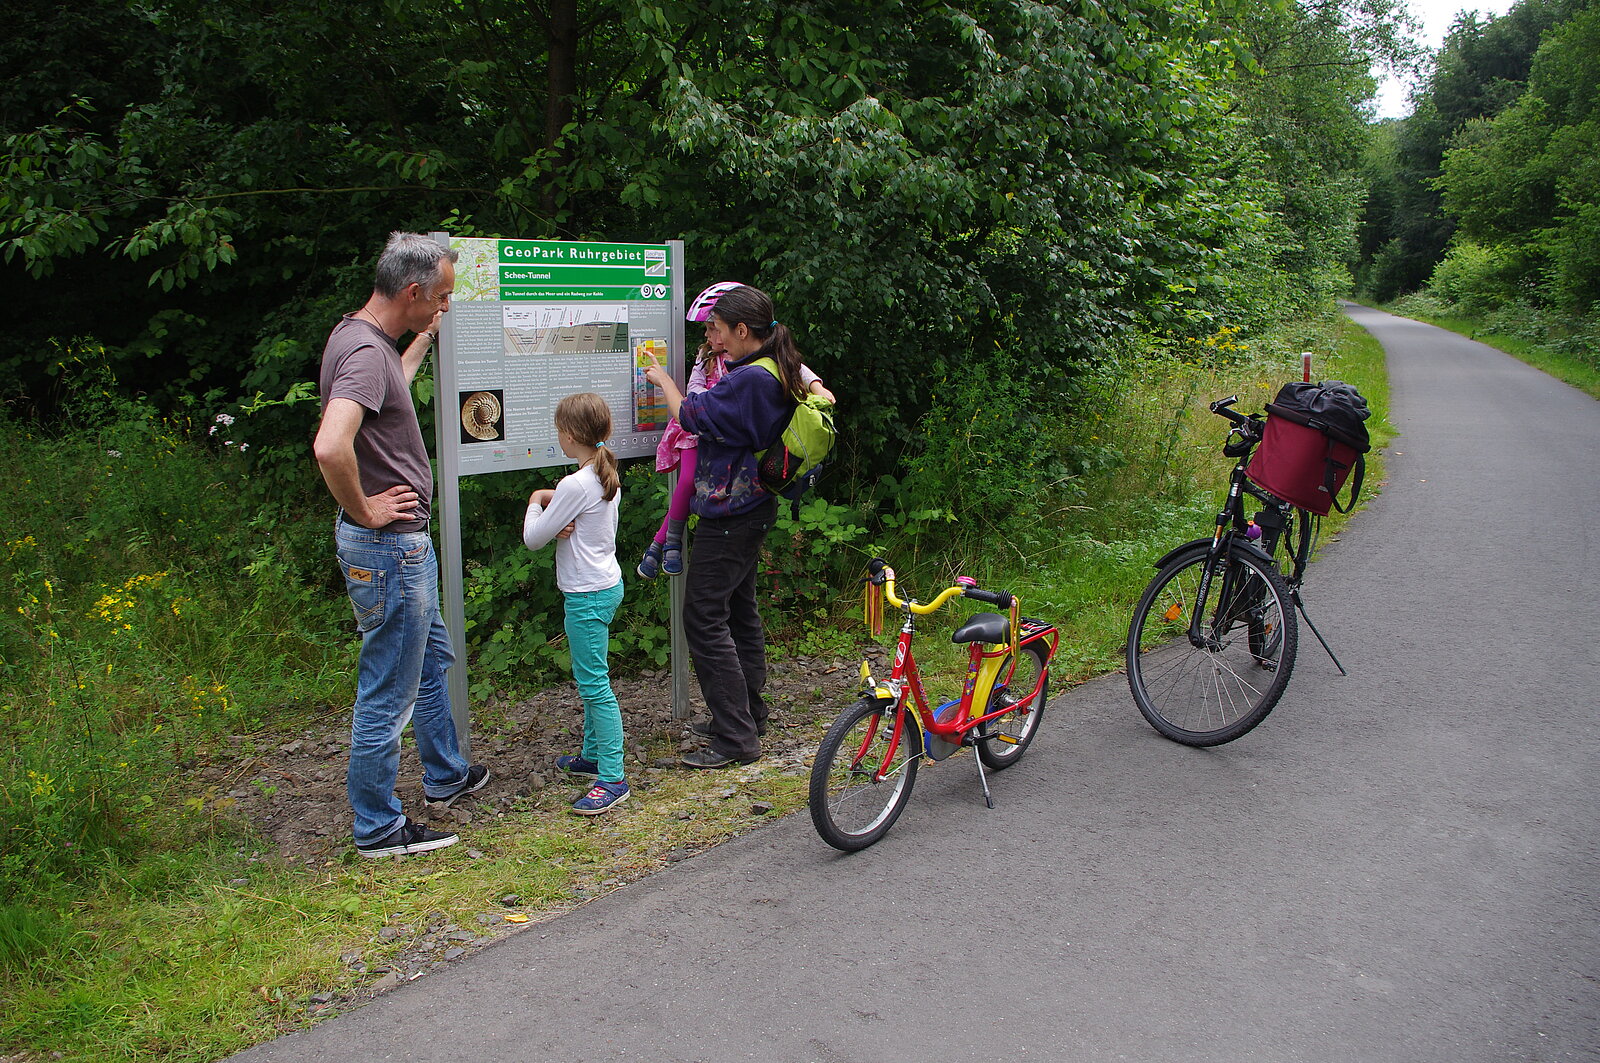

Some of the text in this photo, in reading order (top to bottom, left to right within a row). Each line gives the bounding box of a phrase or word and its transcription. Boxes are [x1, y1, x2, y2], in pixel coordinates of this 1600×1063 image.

[504, 246, 641, 262] GeoPark Ruhrgebiet
[504, 271, 551, 279] Schee-Tunnel
